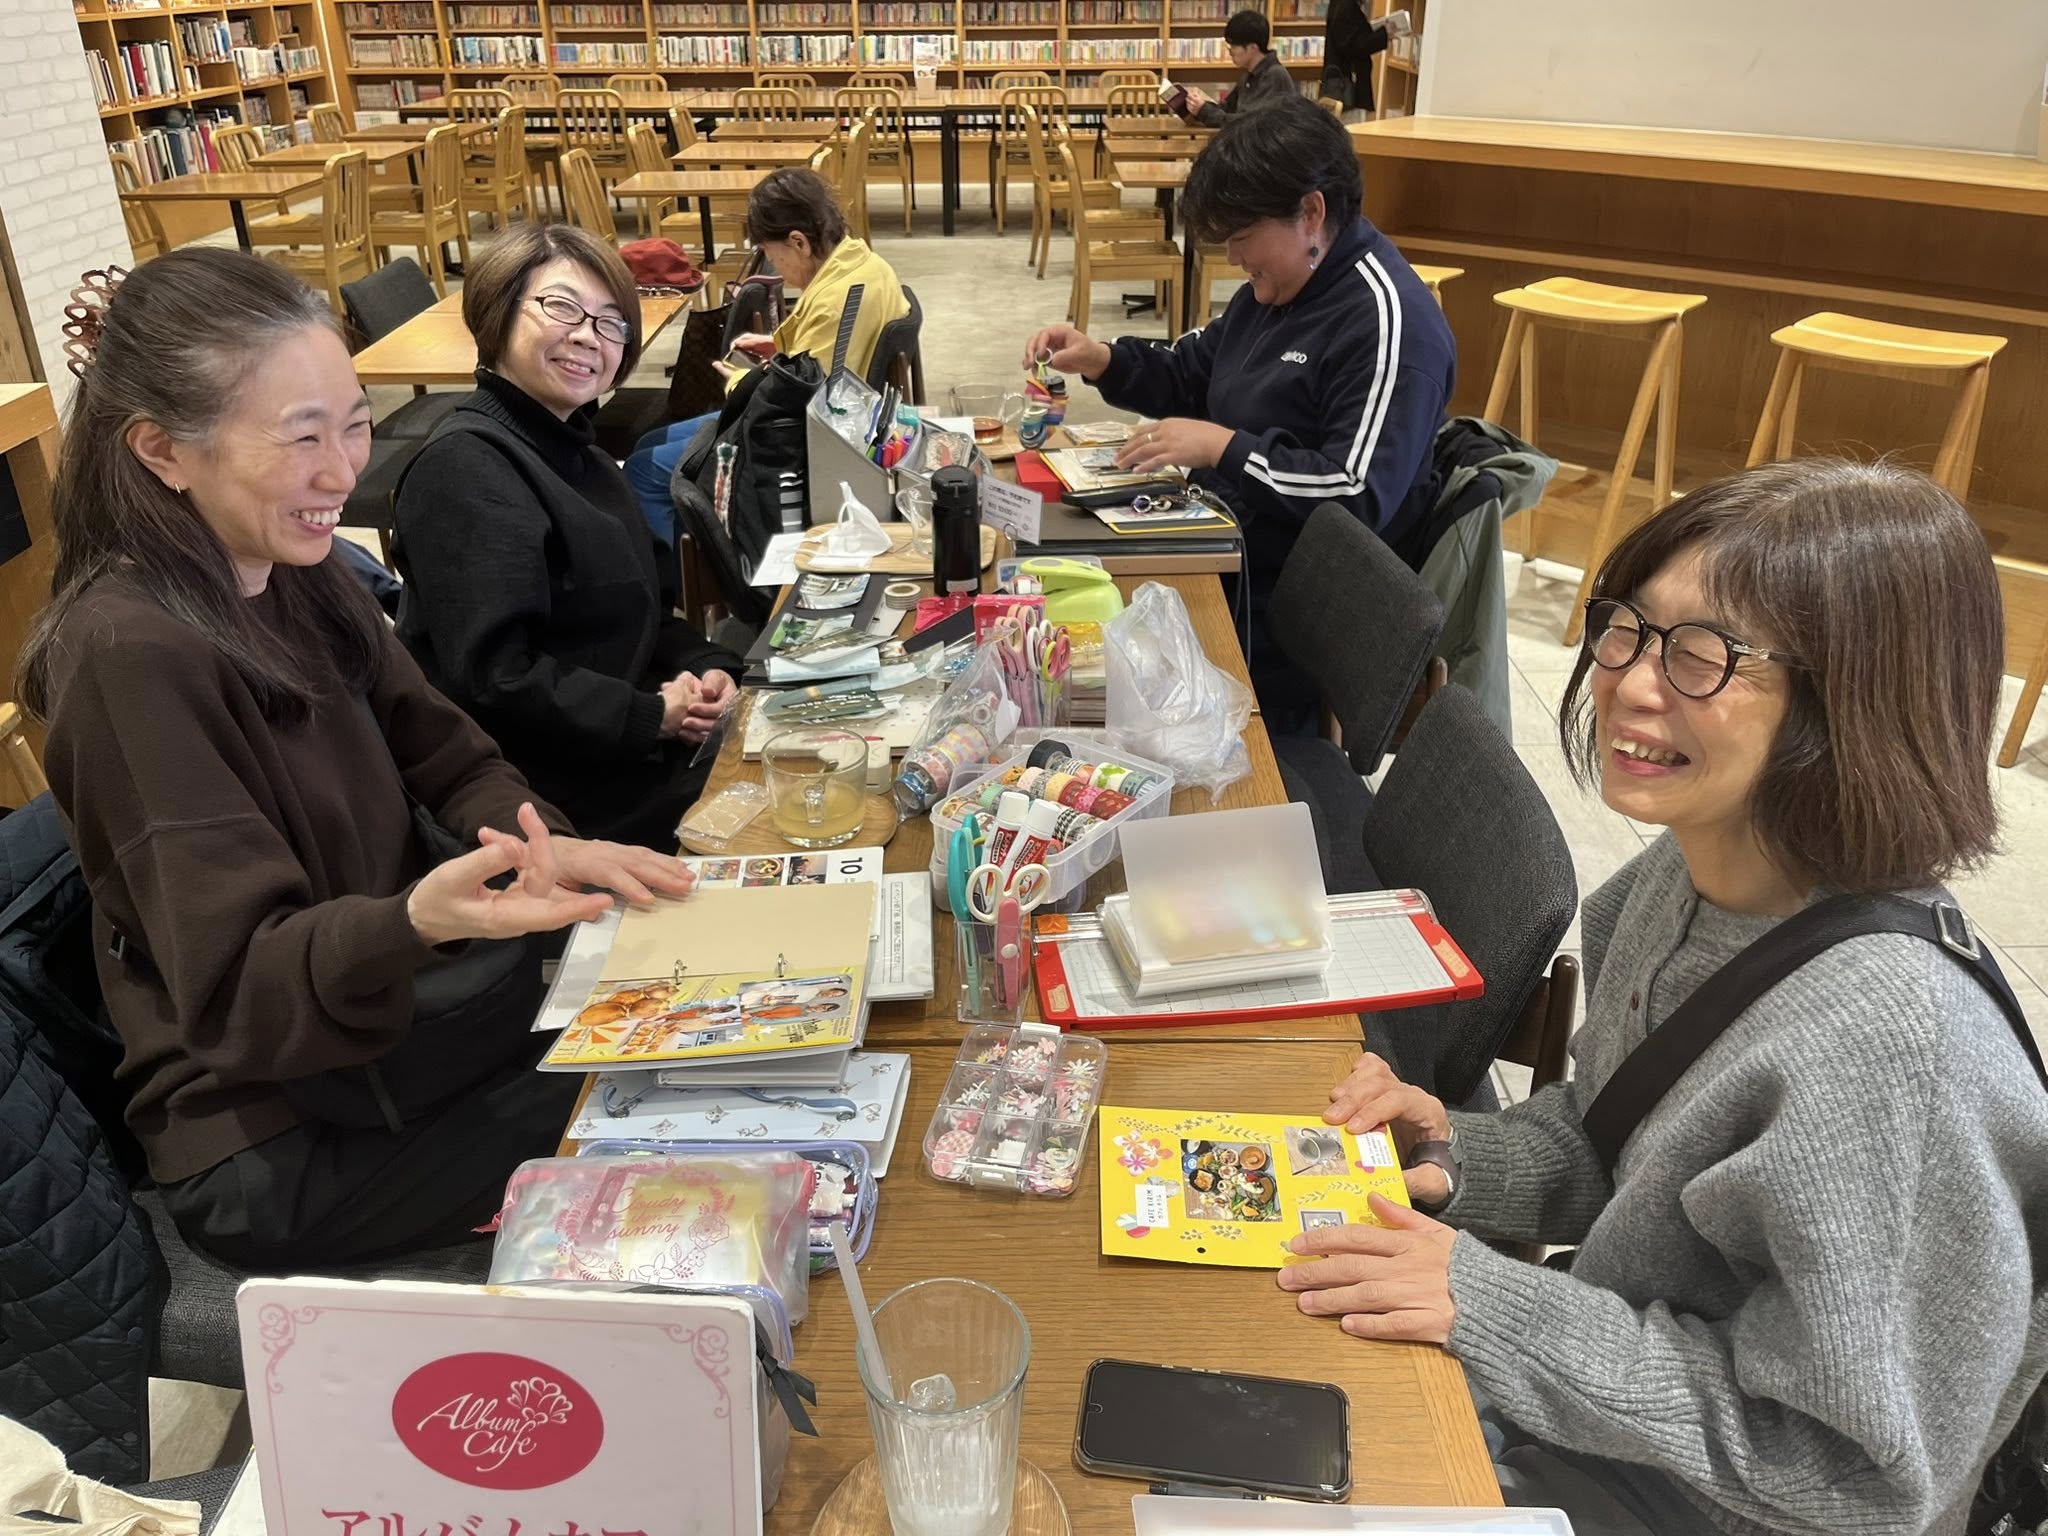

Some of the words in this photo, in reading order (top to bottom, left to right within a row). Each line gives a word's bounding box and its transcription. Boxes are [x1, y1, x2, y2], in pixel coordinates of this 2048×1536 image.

[840, 857, 863, 875] 10
[612, 1188, 686, 1213] Cloudy
[606, 1223, 679, 1241] sunny
[416, 1392, 520, 1433] Album
[463, 1419, 537, 1472] Cafe
